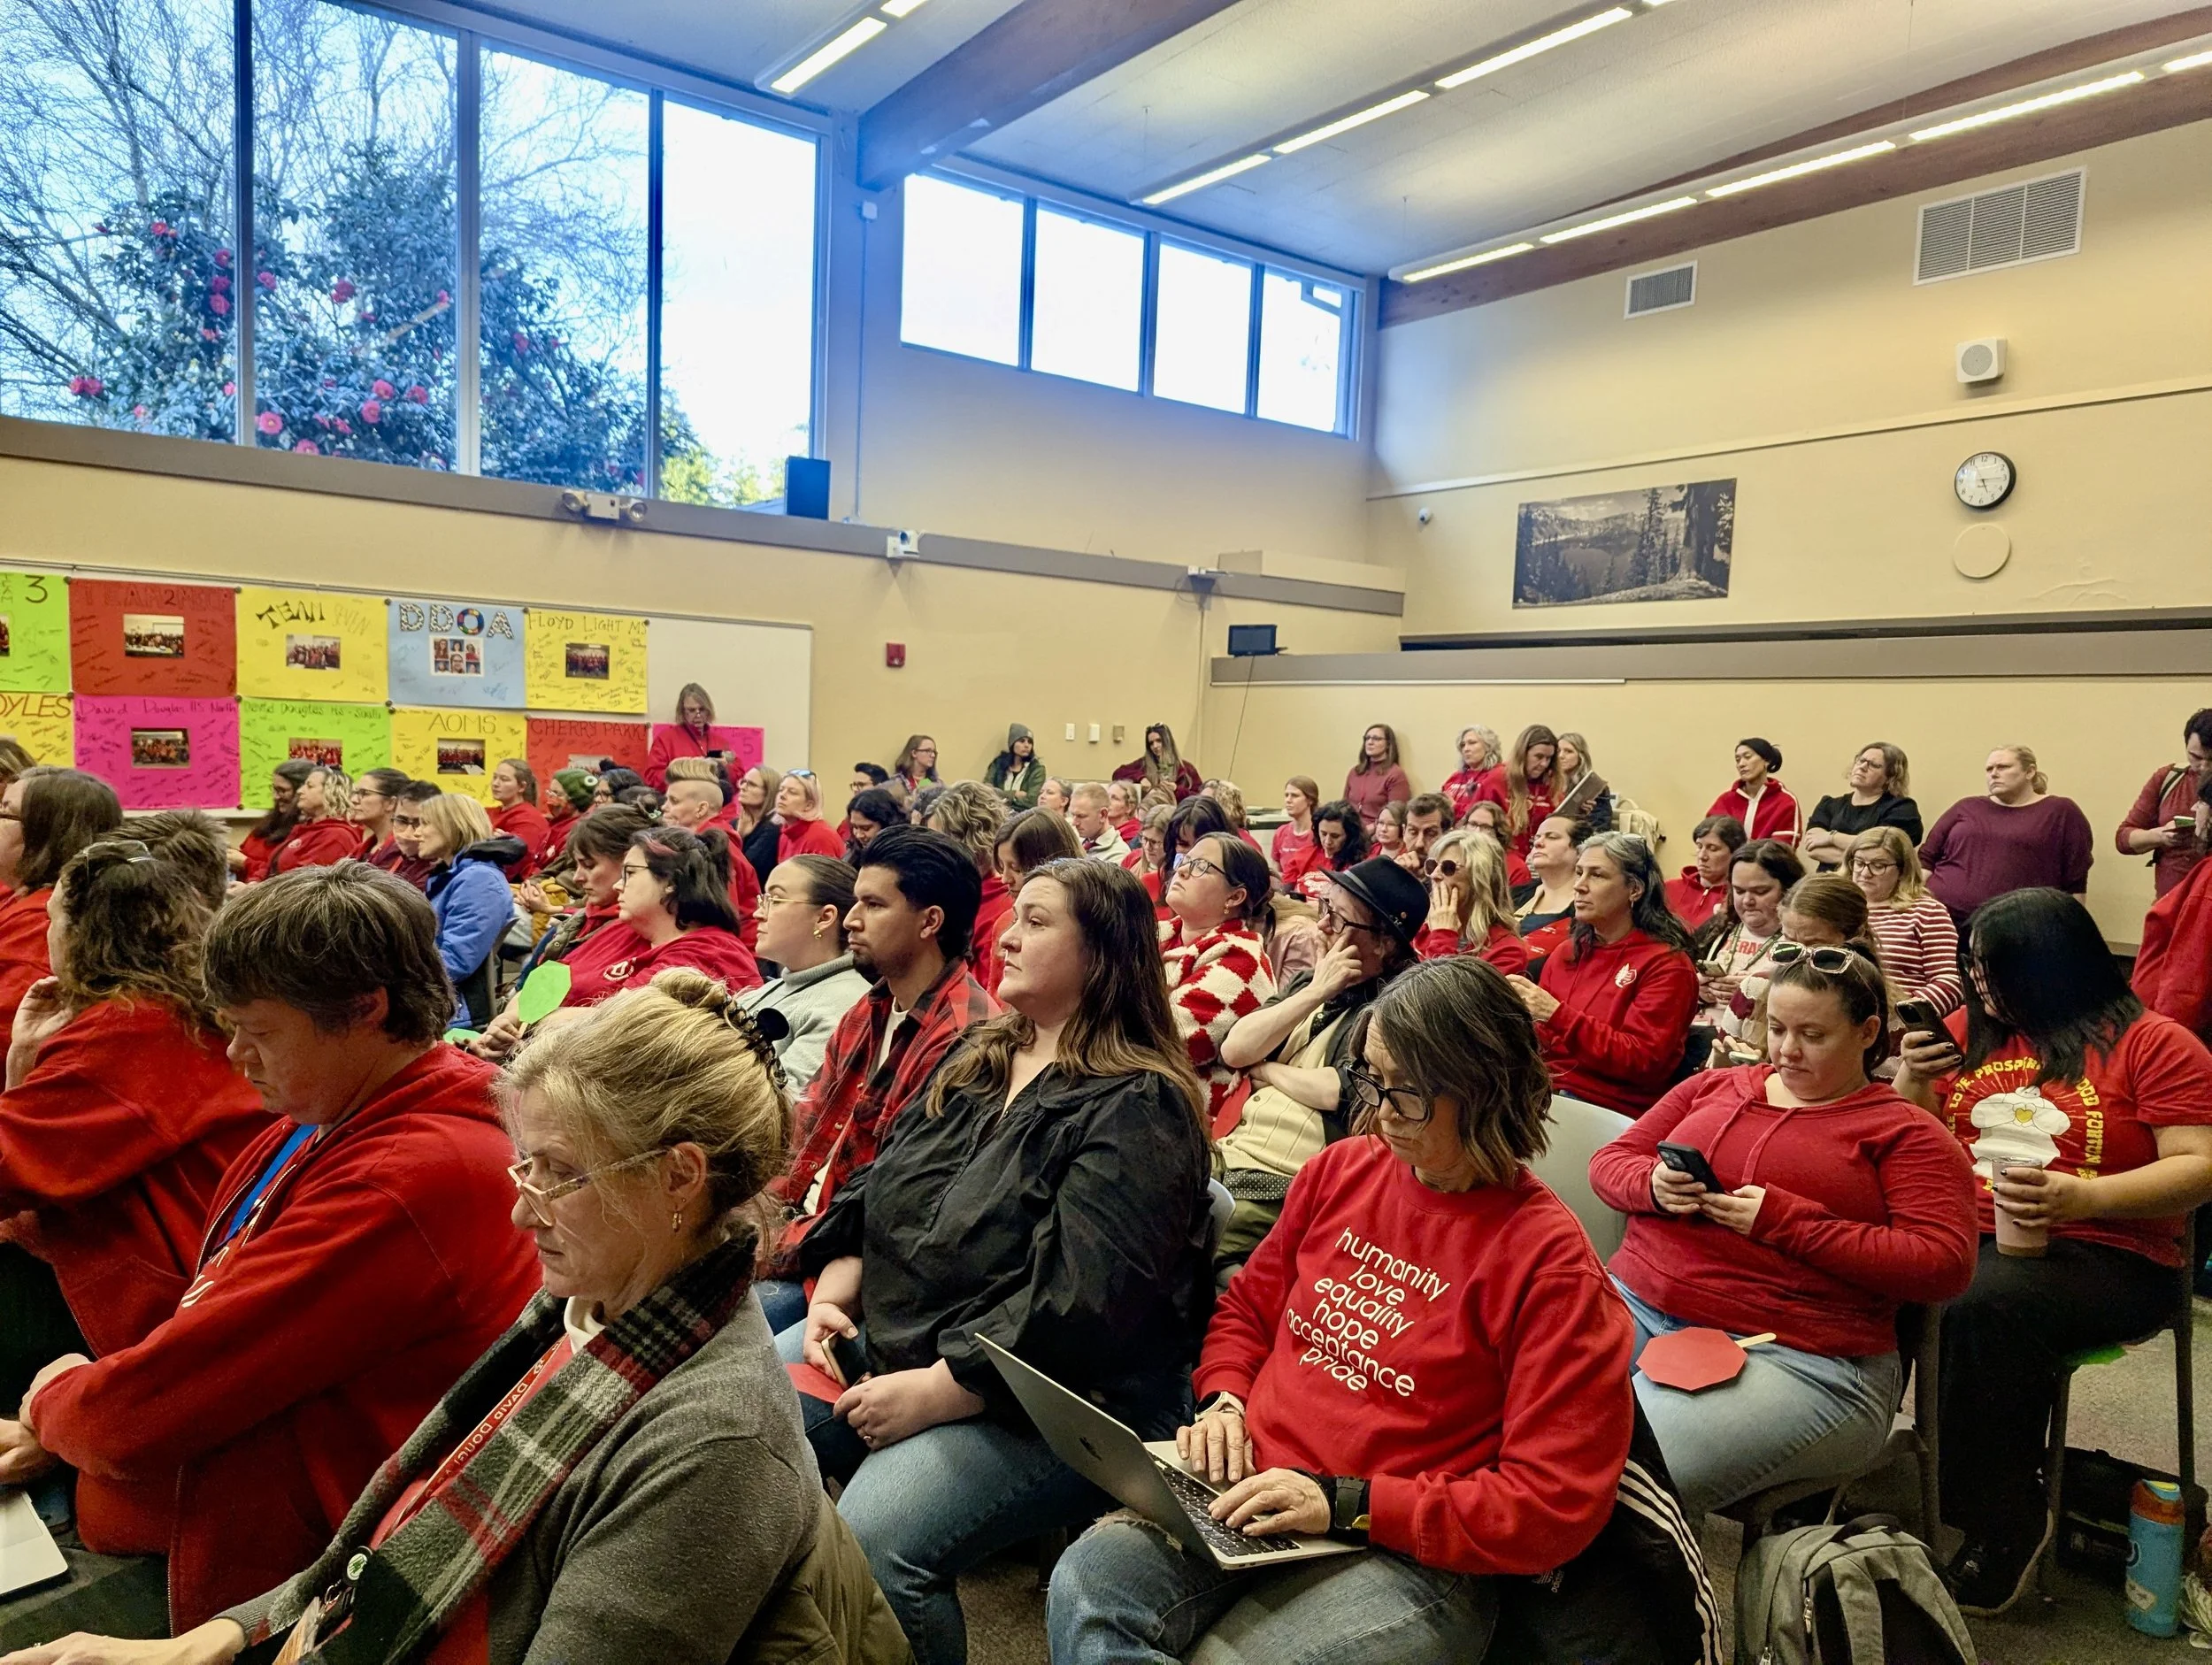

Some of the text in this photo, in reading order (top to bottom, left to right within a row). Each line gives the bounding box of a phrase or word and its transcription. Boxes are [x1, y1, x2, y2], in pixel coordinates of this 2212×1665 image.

[25, 574, 49, 603] 3
[163, 589, 178, 606] 2
[256, 600, 326, 630] TEAM
[399, 602, 515, 640] DDOA
[528, 611, 648, 635] FLOYD LIGHT MS
[79, 699, 127, 716] David
[143, 698, 184, 717] Douglas
[211, 702, 236, 713] North
[243, 700, 274, 713] David
[280, 702, 324, 718] Douglas
[428, 712, 497, 734] AOMS
[531, 717, 597, 739] CHERRY
[741, 736, 755, 756] 5
[1334, 1226, 1451, 1303] humanity
[1348, 1263, 1407, 1306] love
[1314, 1277, 1416, 1339] equality
[1312, 1297, 1379, 1351] hope
[1286, 1307, 1417, 1398] acceptance
[1298, 1346, 1369, 1392] pride
